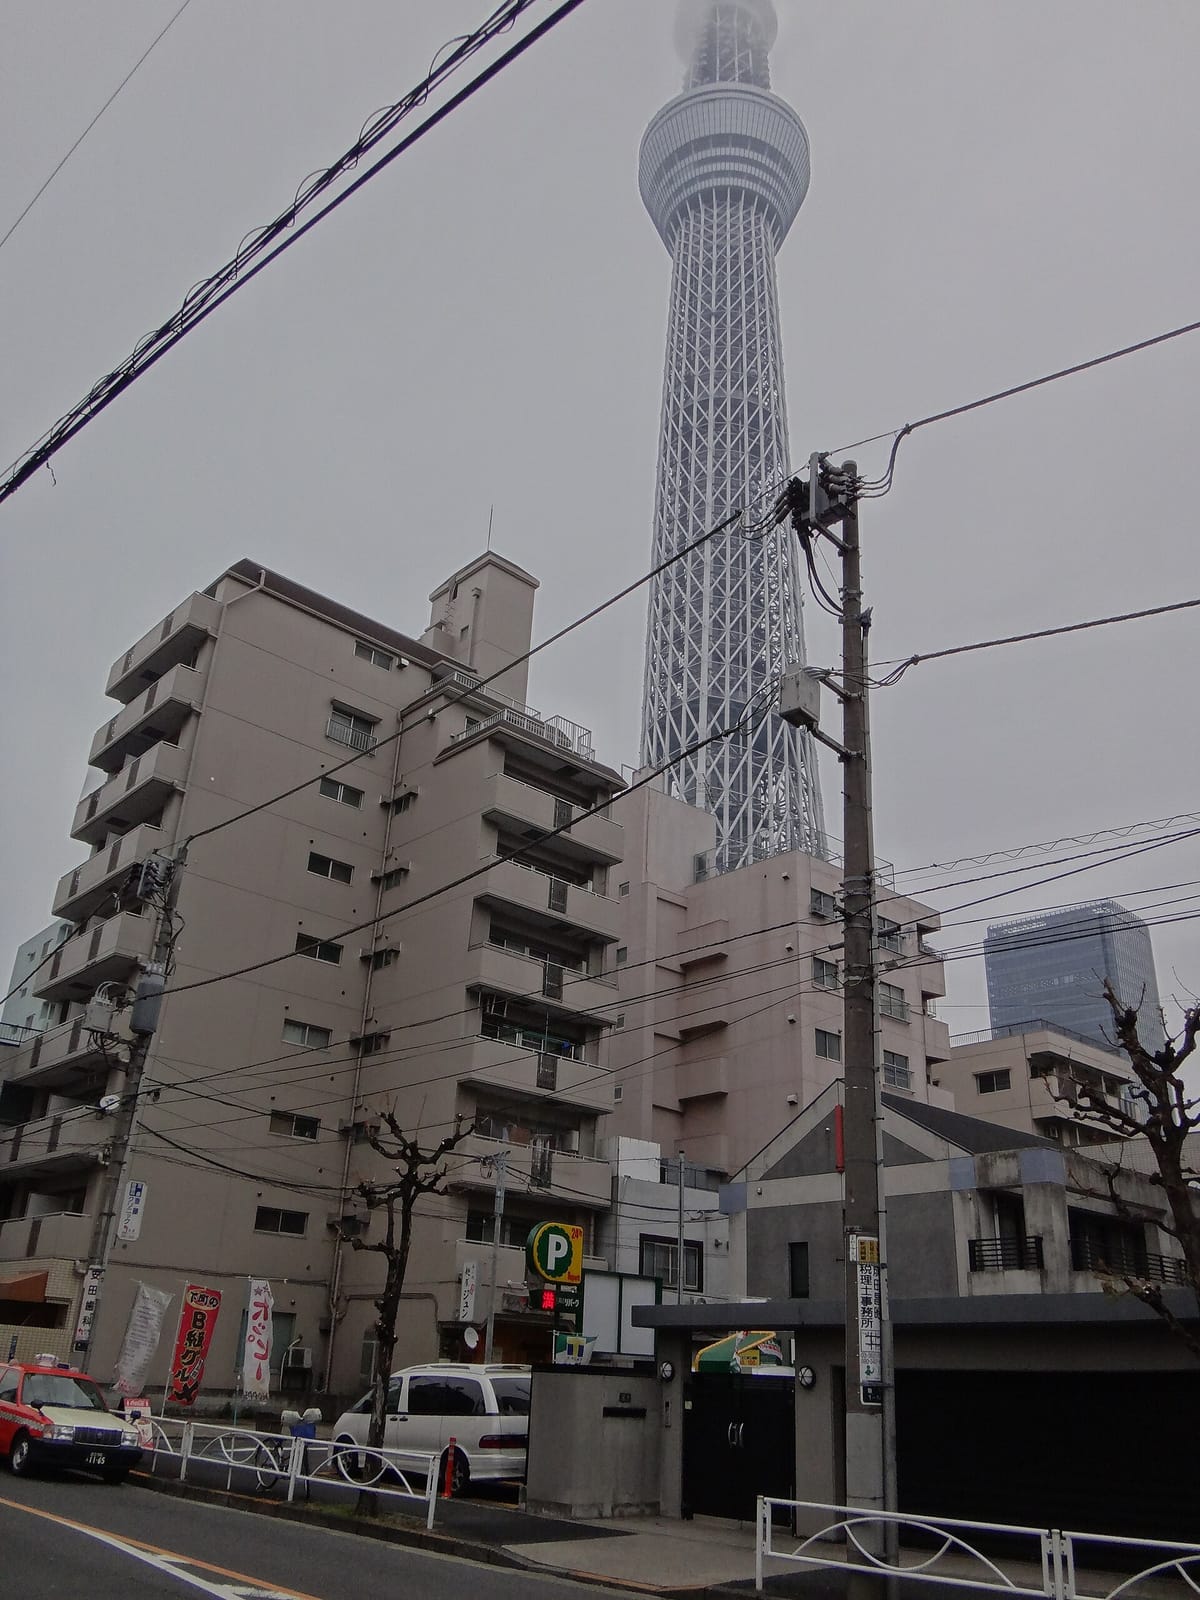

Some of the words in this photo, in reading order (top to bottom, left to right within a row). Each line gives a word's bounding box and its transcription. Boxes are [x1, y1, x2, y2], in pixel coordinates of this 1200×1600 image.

[546, 1233, 568, 1271] P
[190, 1291, 219, 1308] 下町の
[541, 1290, 556, 1311] 満
[860, 1264, 873, 1328] 税理士事務所
